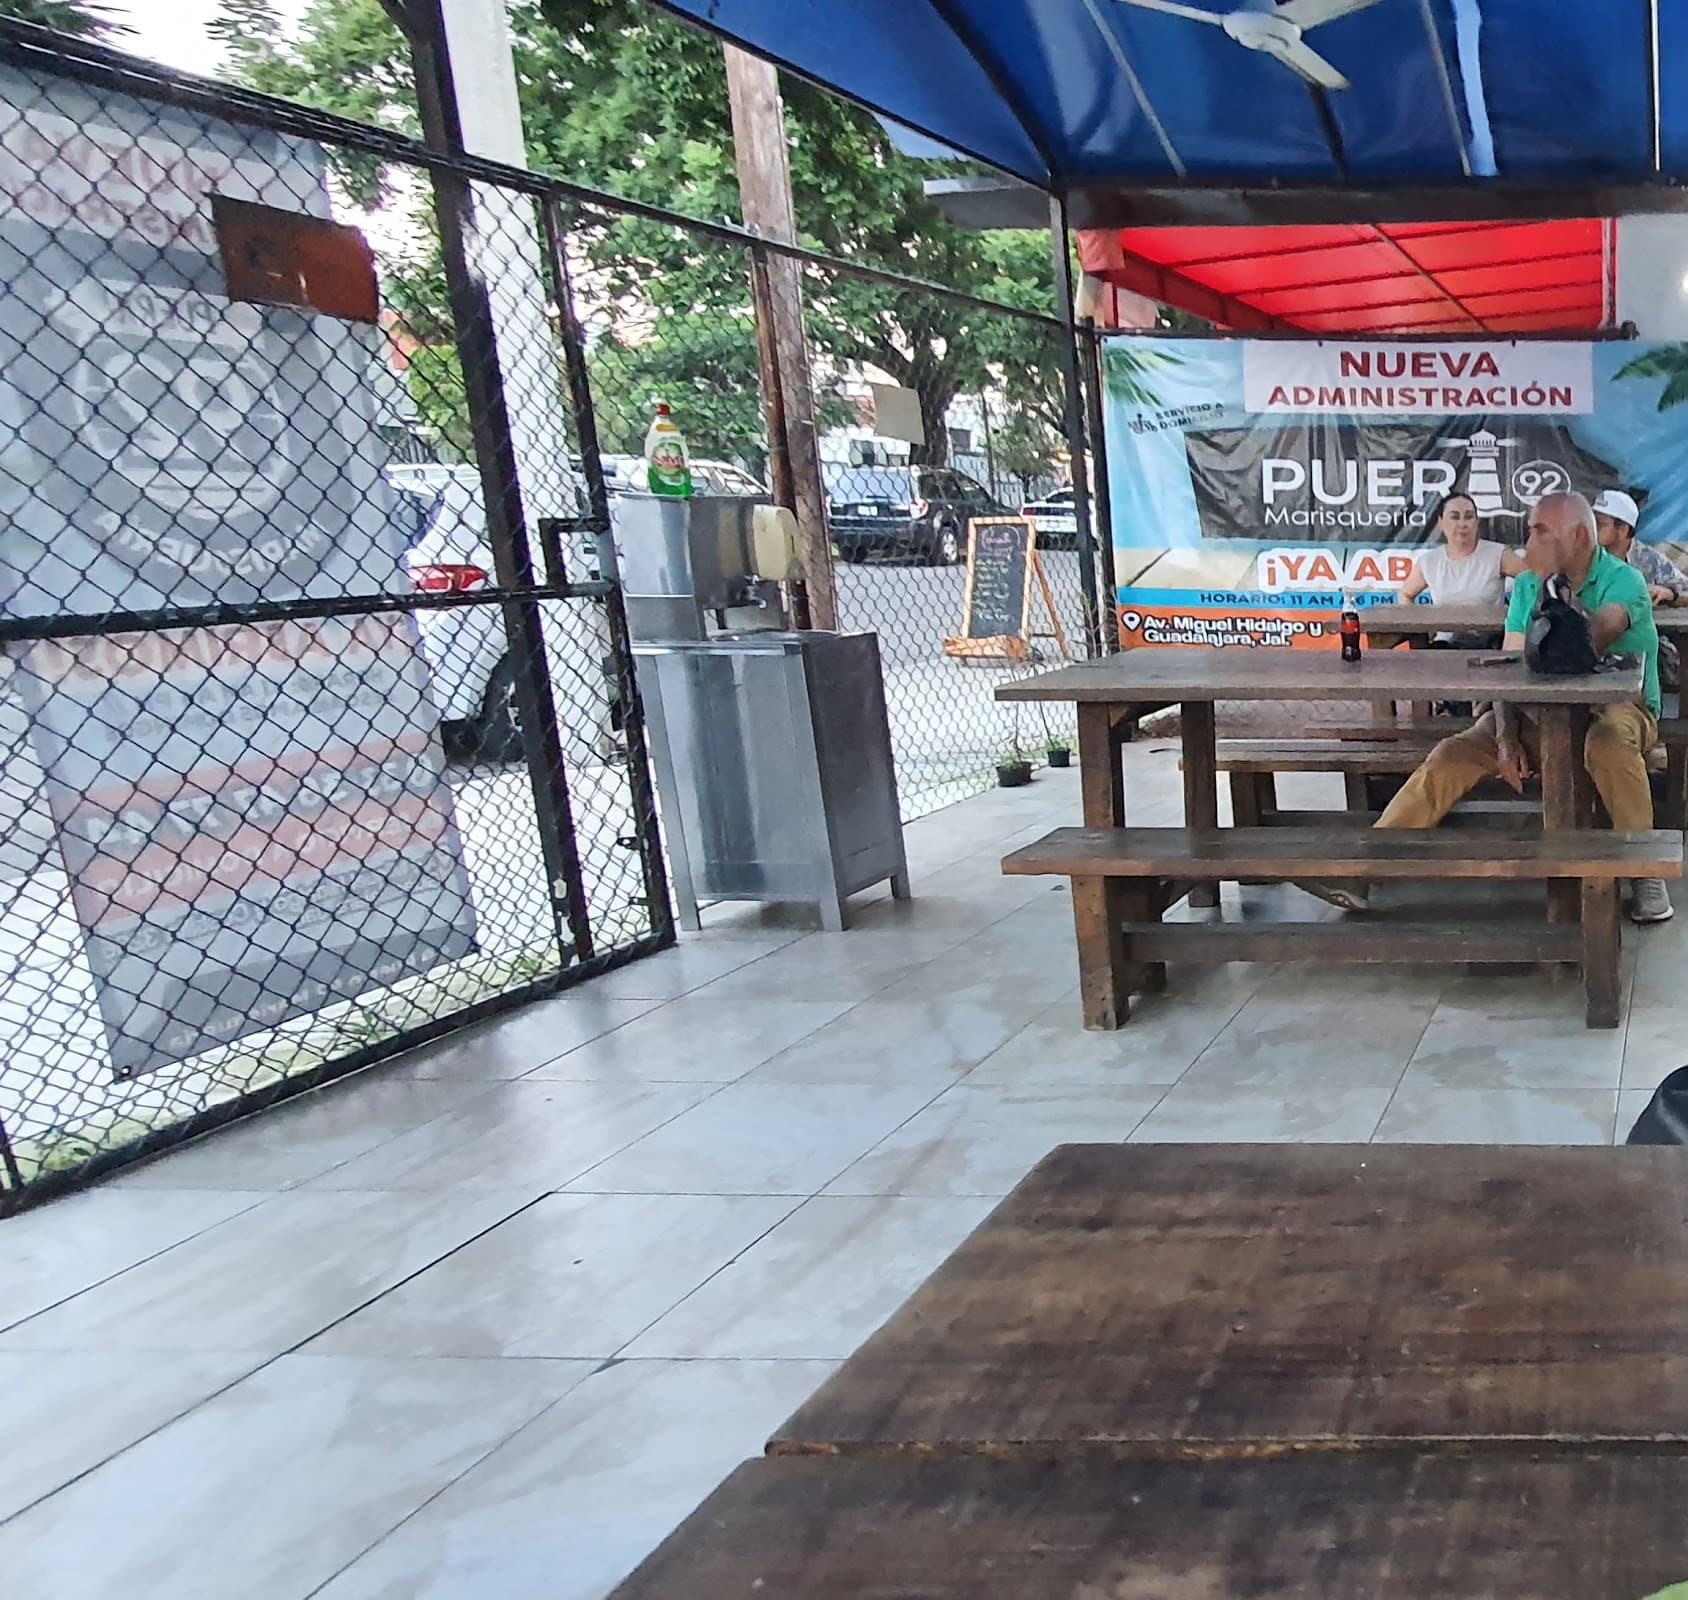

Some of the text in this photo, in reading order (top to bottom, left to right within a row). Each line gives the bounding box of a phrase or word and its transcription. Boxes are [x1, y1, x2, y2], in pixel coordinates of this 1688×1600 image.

[1339, 350, 1501, 379] NUEVA
[1267, 380, 1573, 408] ADMINISTRACIÓN
[1155, 402, 1225, 421] SERVICIO A
[1518, 470, 1563, 497] 92
[1263, 505, 1428, 530] Marisquería
[1265, 554, 1338, 587] ¡YA
[1200, 593, 1287, 605] HORARIO:
[1290, 594, 1304, 605] 11
[1308, 594, 1334, 606] AM
[1370, 595, 1394, 605] PM
[1144, 615, 1322, 636] Av. Miguel Hidalgo y
[1144, 630, 1290, 647] Guadalajara, Jal.
